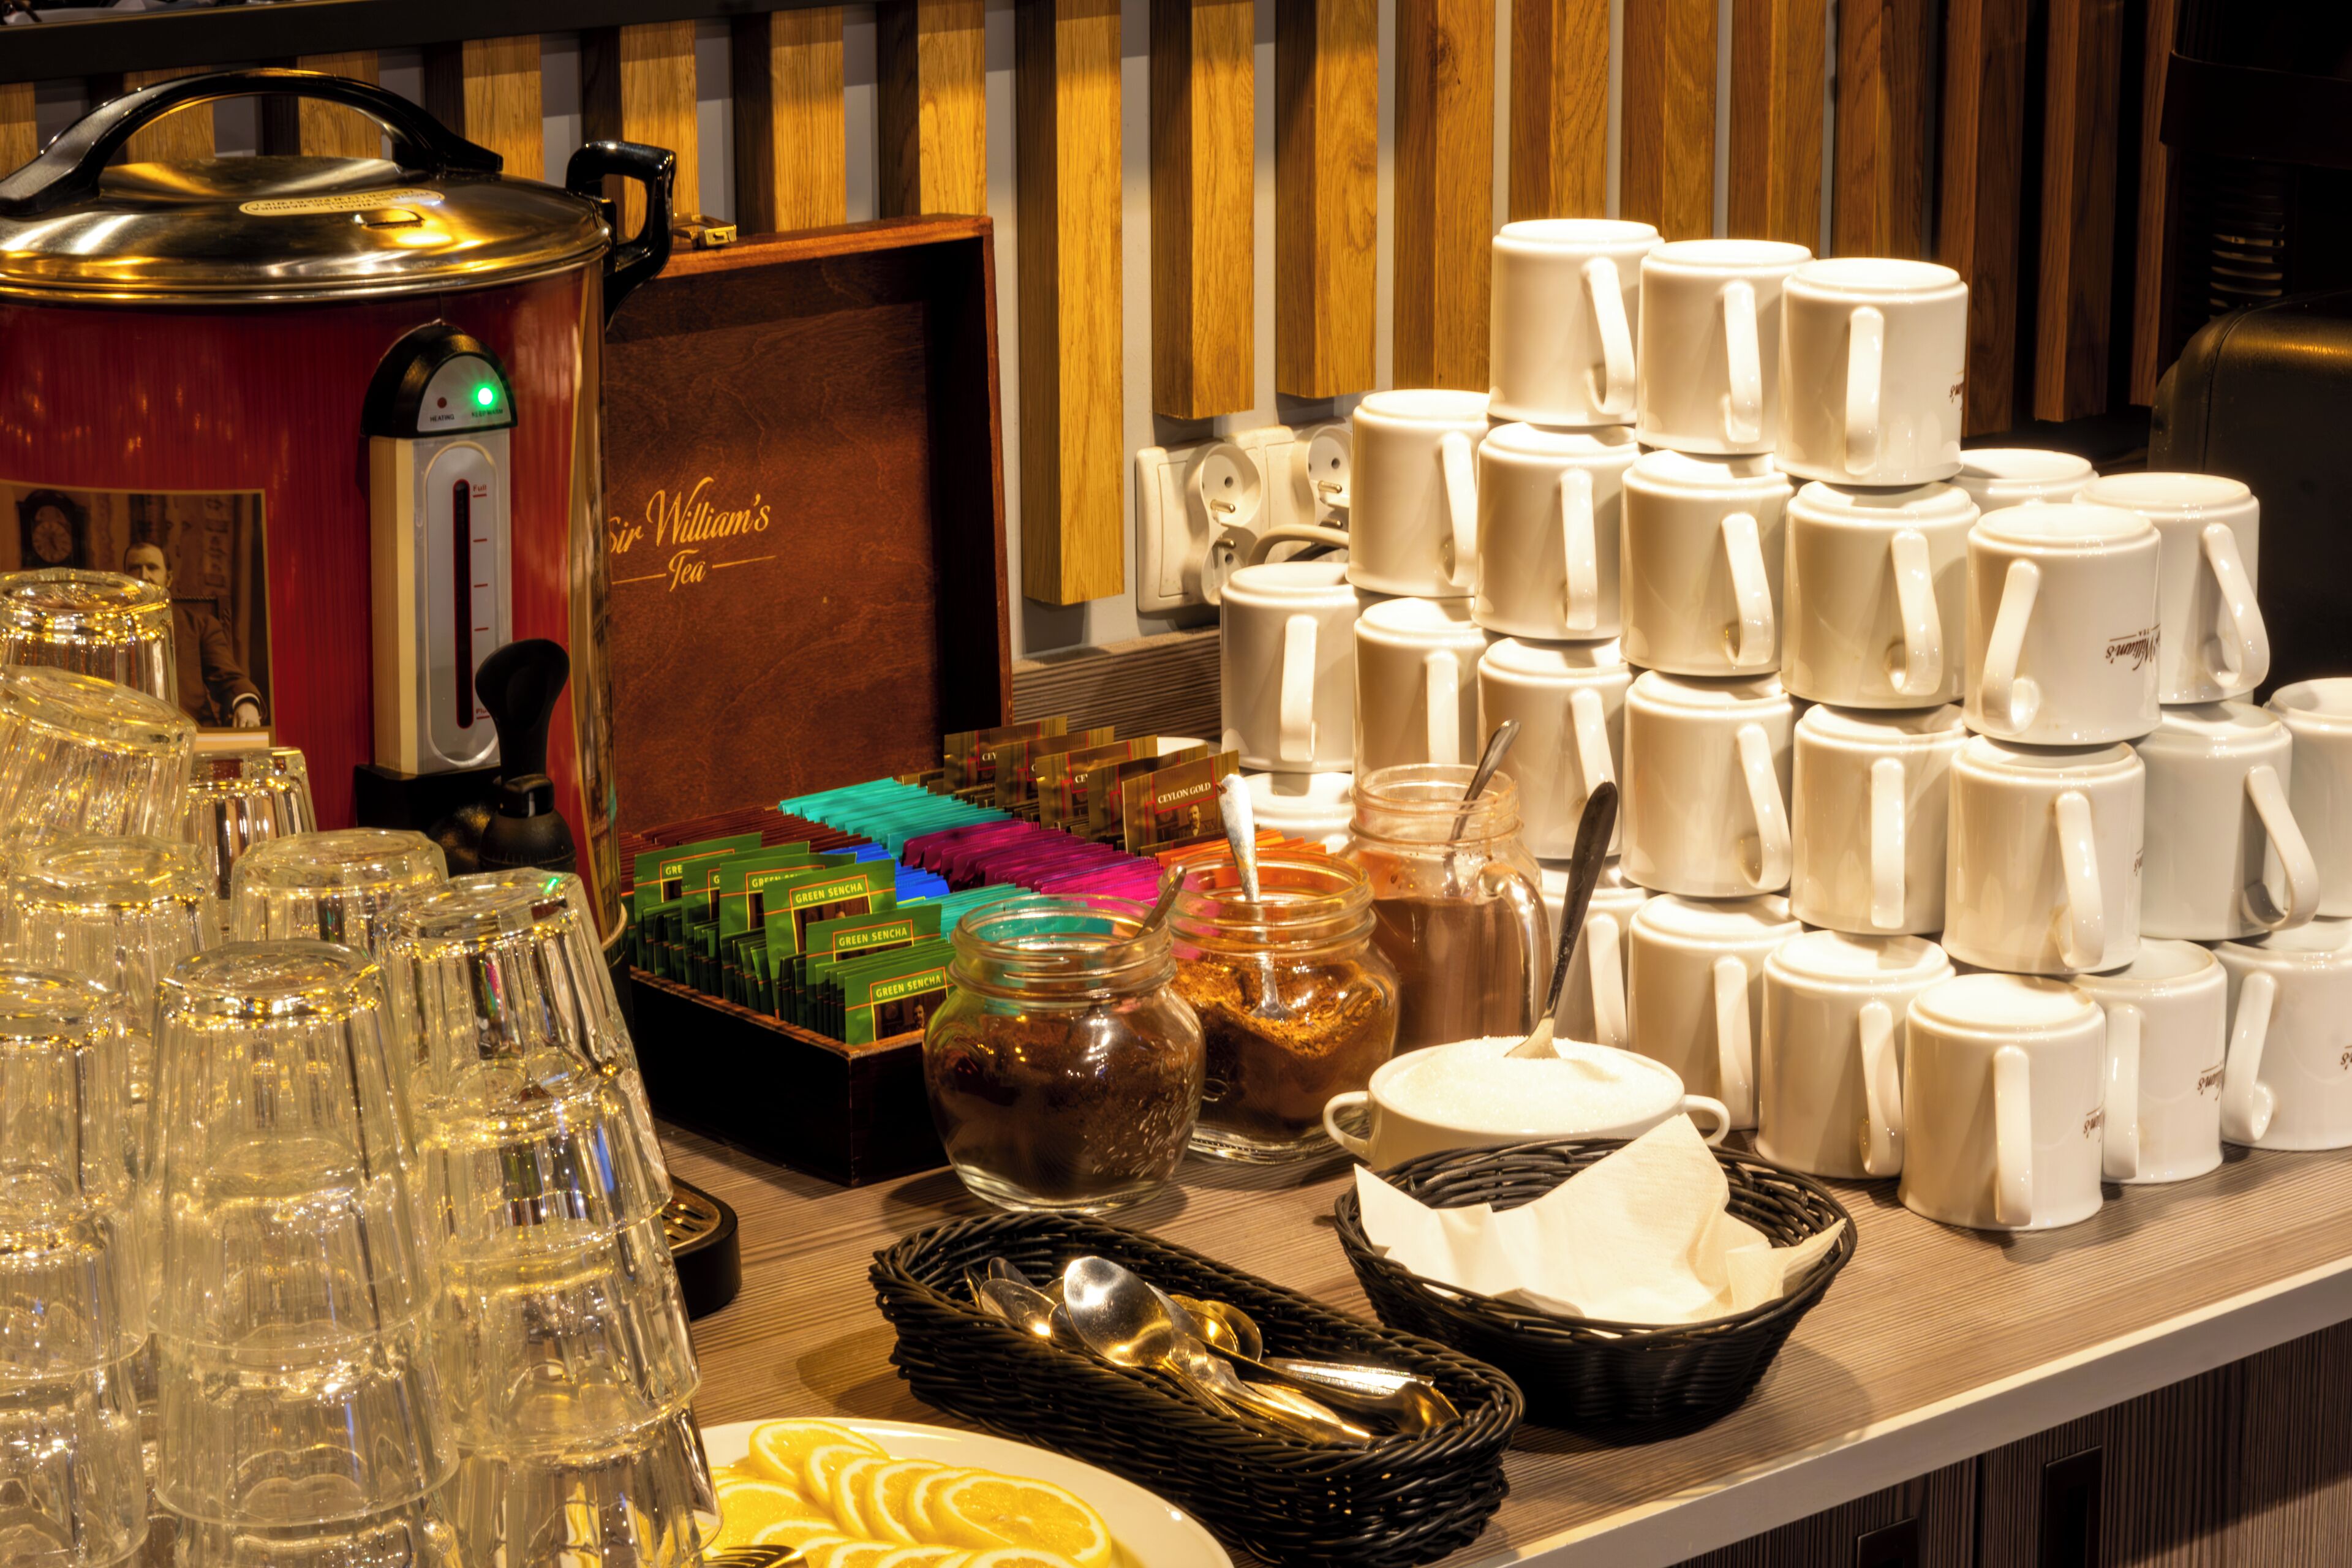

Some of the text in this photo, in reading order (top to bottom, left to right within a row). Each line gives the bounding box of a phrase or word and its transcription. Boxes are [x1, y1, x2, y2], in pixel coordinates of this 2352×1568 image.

[646, 476, 771, 547] William's
[668, 549, 706, 592] Tea
[1158, 782, 1211, 804] CEYLON GOLD
[665, 864, 683, 875] GRE
[795, 882, 863, 903] GREEN SENCHA
[839, 927, 907, 946] GREEN SENCHA
[876, 974, 941, 998] GREEN SENCHA
